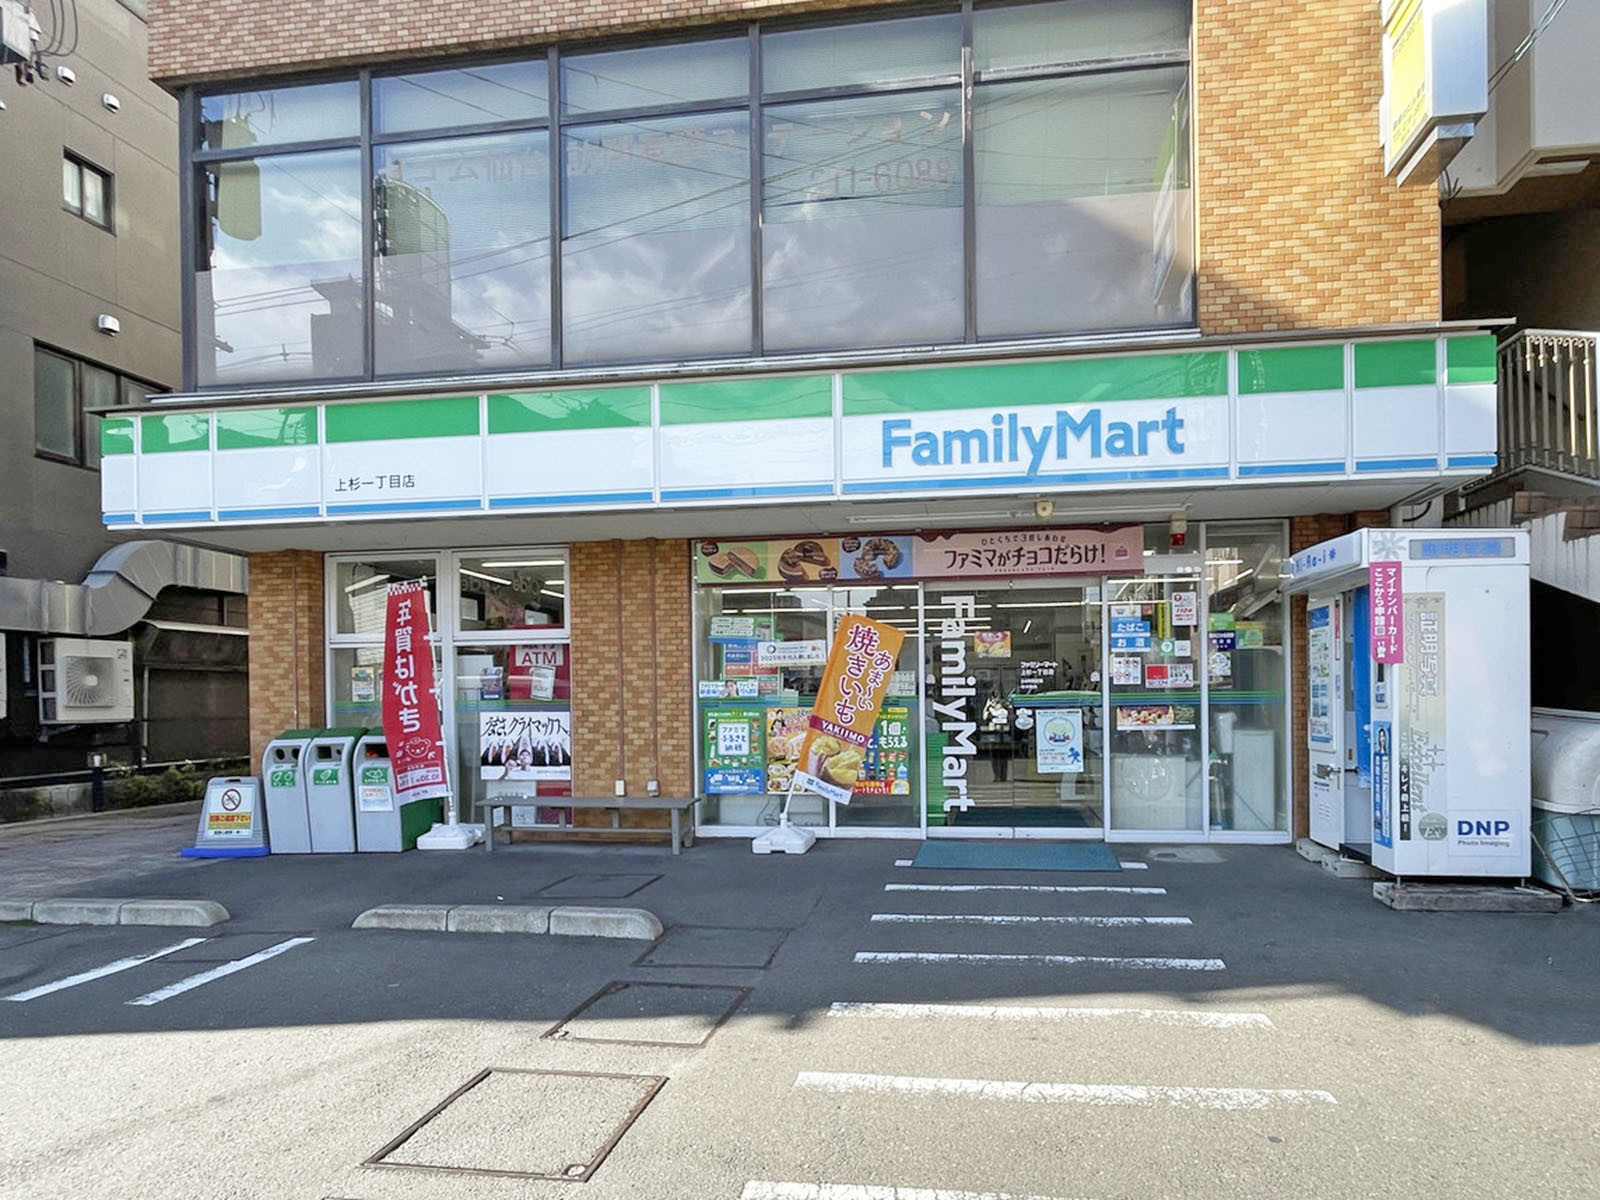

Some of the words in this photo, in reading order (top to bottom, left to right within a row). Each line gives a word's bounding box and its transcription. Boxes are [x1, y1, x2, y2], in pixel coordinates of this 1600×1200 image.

[882, 407, 1185, 477] FamilyMart
[335, 474, 415, 492] 上杉一丁目店
[944, 544, 1106, 569] ファミマがチョコだらけ!
[1387, 567, 1398, 655] マイナンバーカード
[1117, 622, 1145, 633] たばこ
[1117, 638, 1145, 648] お酒
[1420, 608, 1438, 698] 証明写真
[522, 652, 557, 665] ATM
[835, 624, 880, 725] 焼きいも
[933, 595, 977, 812] FamilyMart
[821, 720, 866, 744] YAKIIMO
[1458, 820, 1510, 836] DNP
